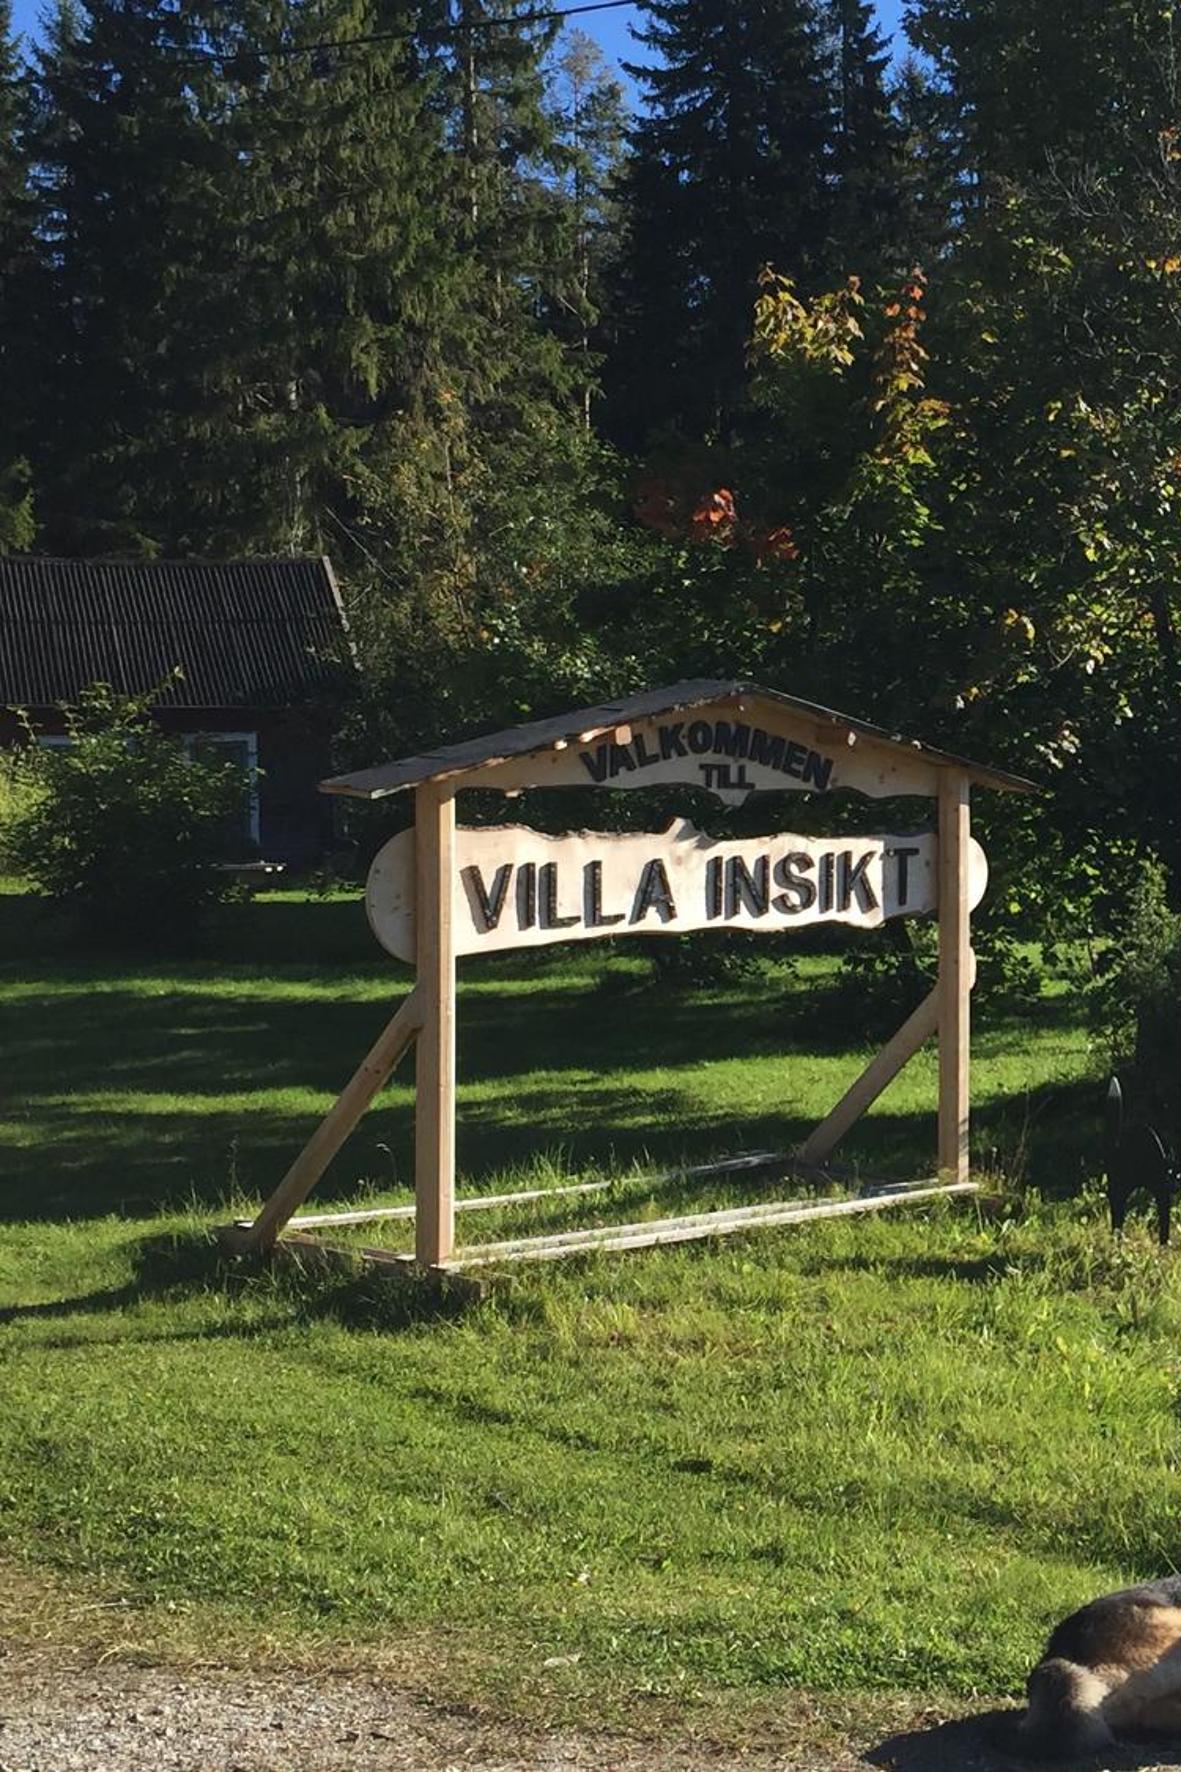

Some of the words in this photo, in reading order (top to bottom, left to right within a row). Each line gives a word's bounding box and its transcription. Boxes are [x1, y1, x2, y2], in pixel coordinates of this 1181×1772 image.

[699, 763, 756, 790] TILL
[460, 859, 678, 934] VILLA
[706, 848, 919, 921] INSIKT
